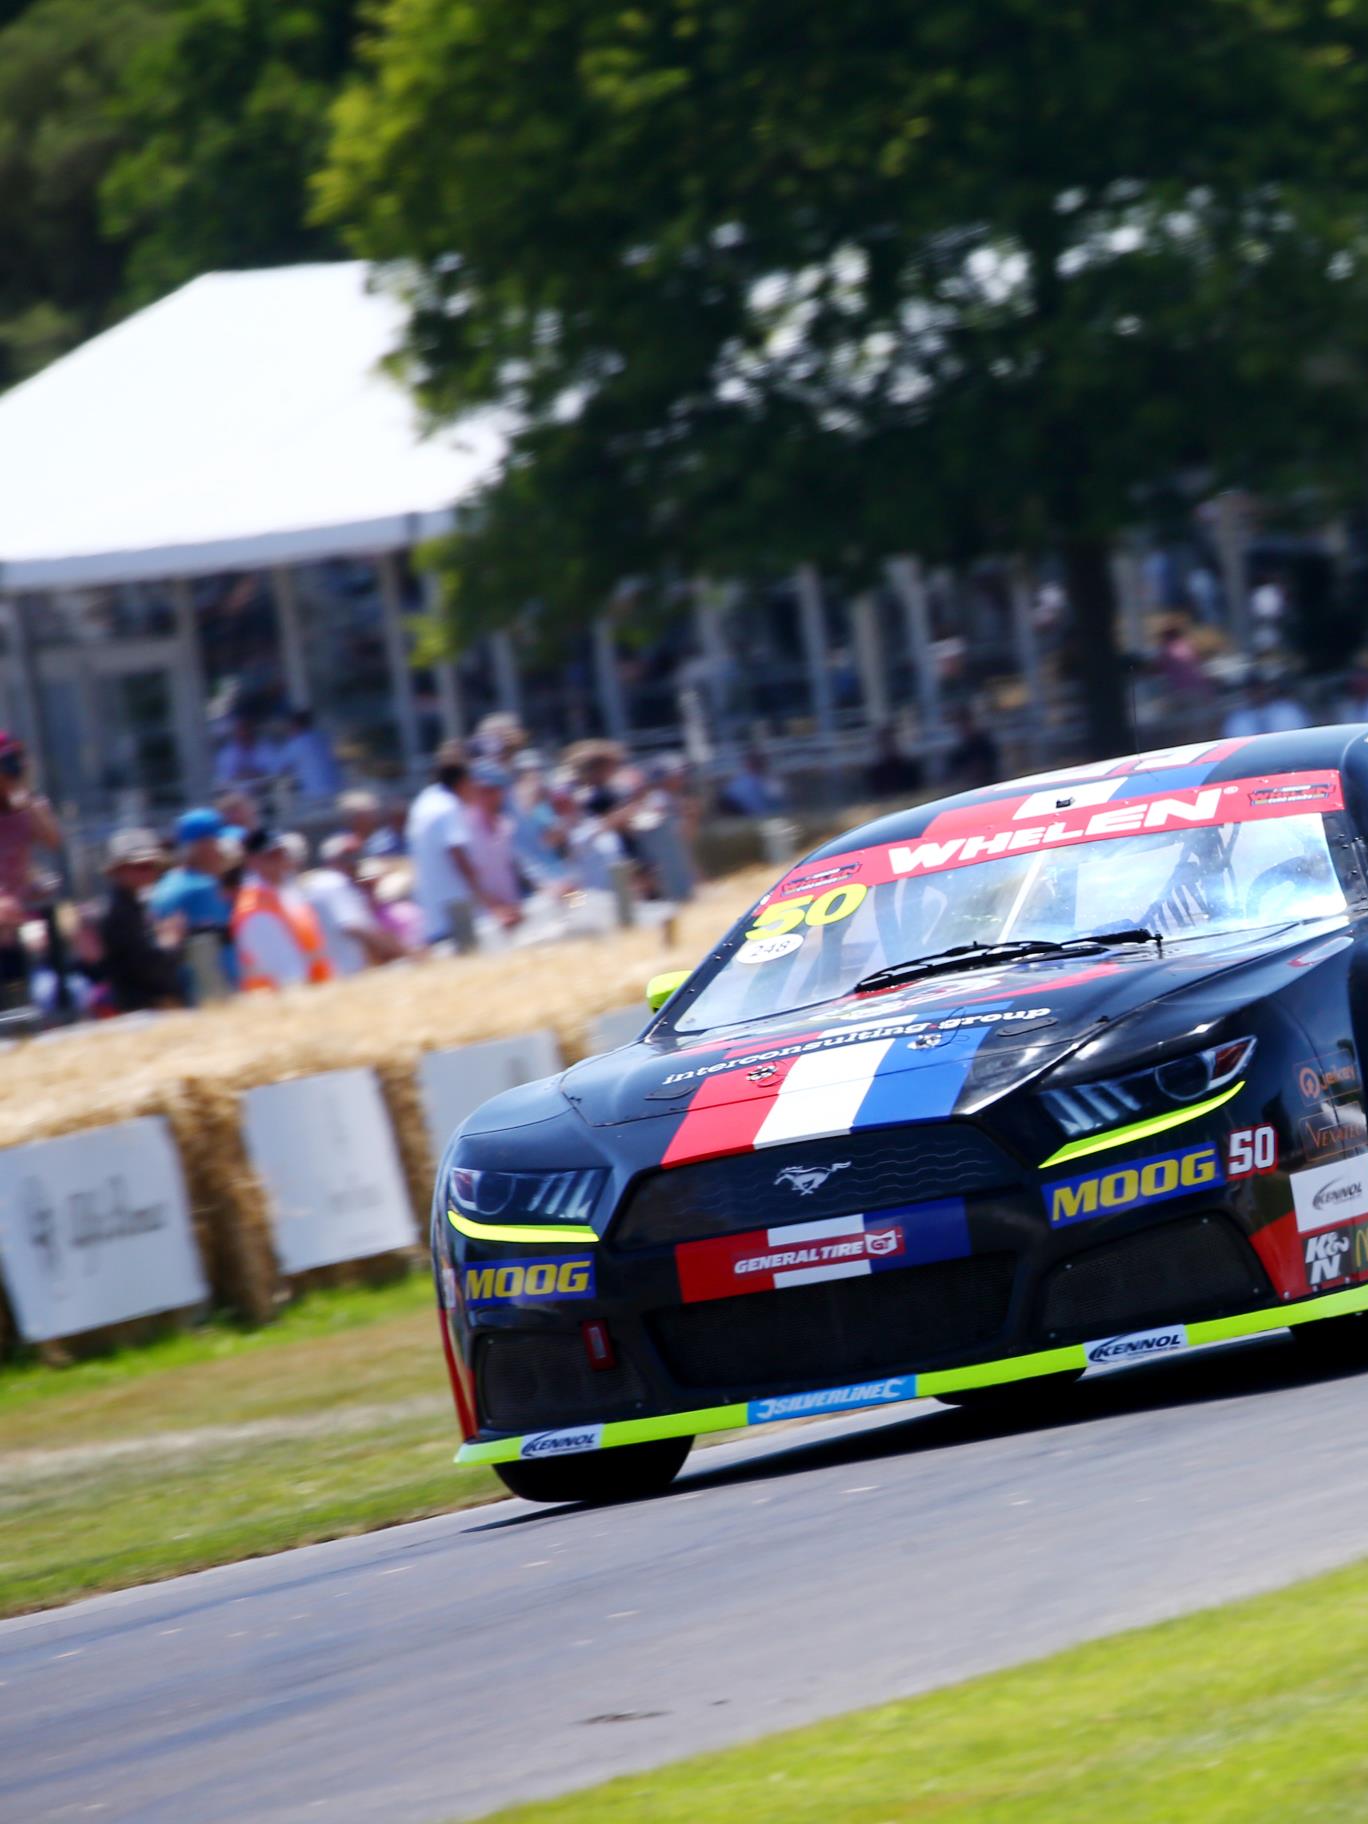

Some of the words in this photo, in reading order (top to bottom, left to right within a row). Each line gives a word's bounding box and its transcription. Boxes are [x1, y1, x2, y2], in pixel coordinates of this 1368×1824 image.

[888, 788, 1222, 875] WHELEN
[744, 883, 868, 941] 50
[1228, 1125, 1275, 1175] 50
[1051, 1148, 1216, 1221] MOOG
[733, 1249, 819, 1274] GENERAL
[819, 1240, 865, 1259] TIRE
[464, 1260, 592, 1300] MOOG
[1096, 1333, 1182, 1359] KENNOL
[527, 1432, 597, 1453] KENNOL
